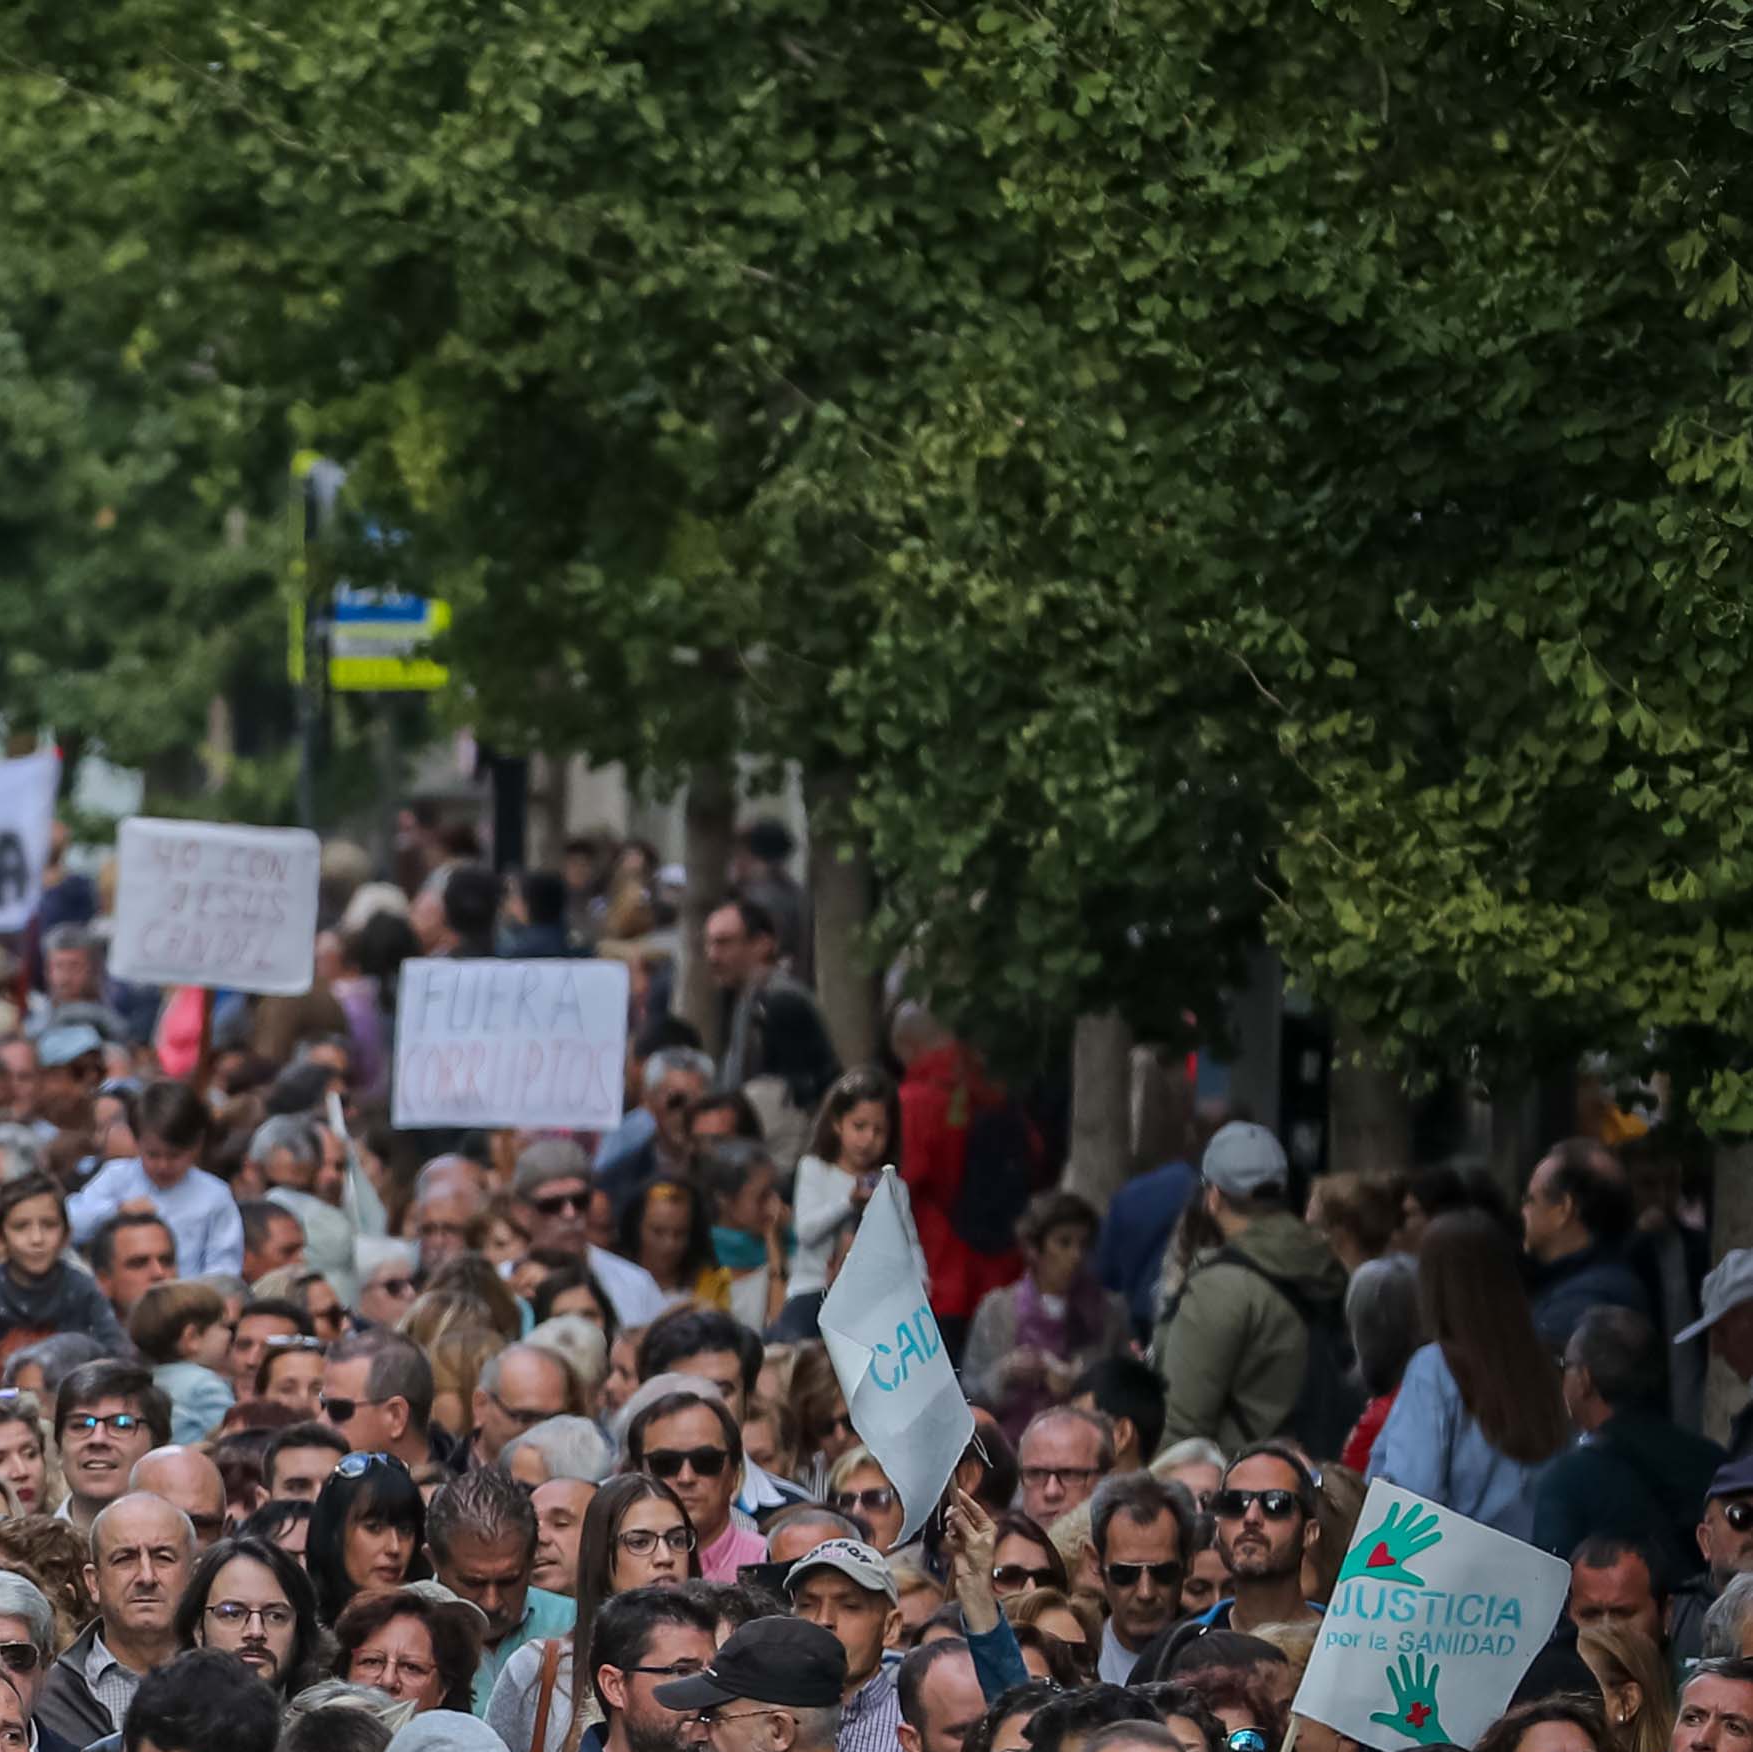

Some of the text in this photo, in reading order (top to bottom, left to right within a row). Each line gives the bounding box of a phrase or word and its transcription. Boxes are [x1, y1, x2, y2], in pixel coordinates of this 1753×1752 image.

[224, 847, 289, 883] CON
[417, 966, 585, 1033] FUERA
[400, 1038, 616, 1112] CORRUPTOS
[1331, 1583, 1523, 1631] JUSTICIA
[1324, 1630, 1518, 1658] por la SANIDAD
